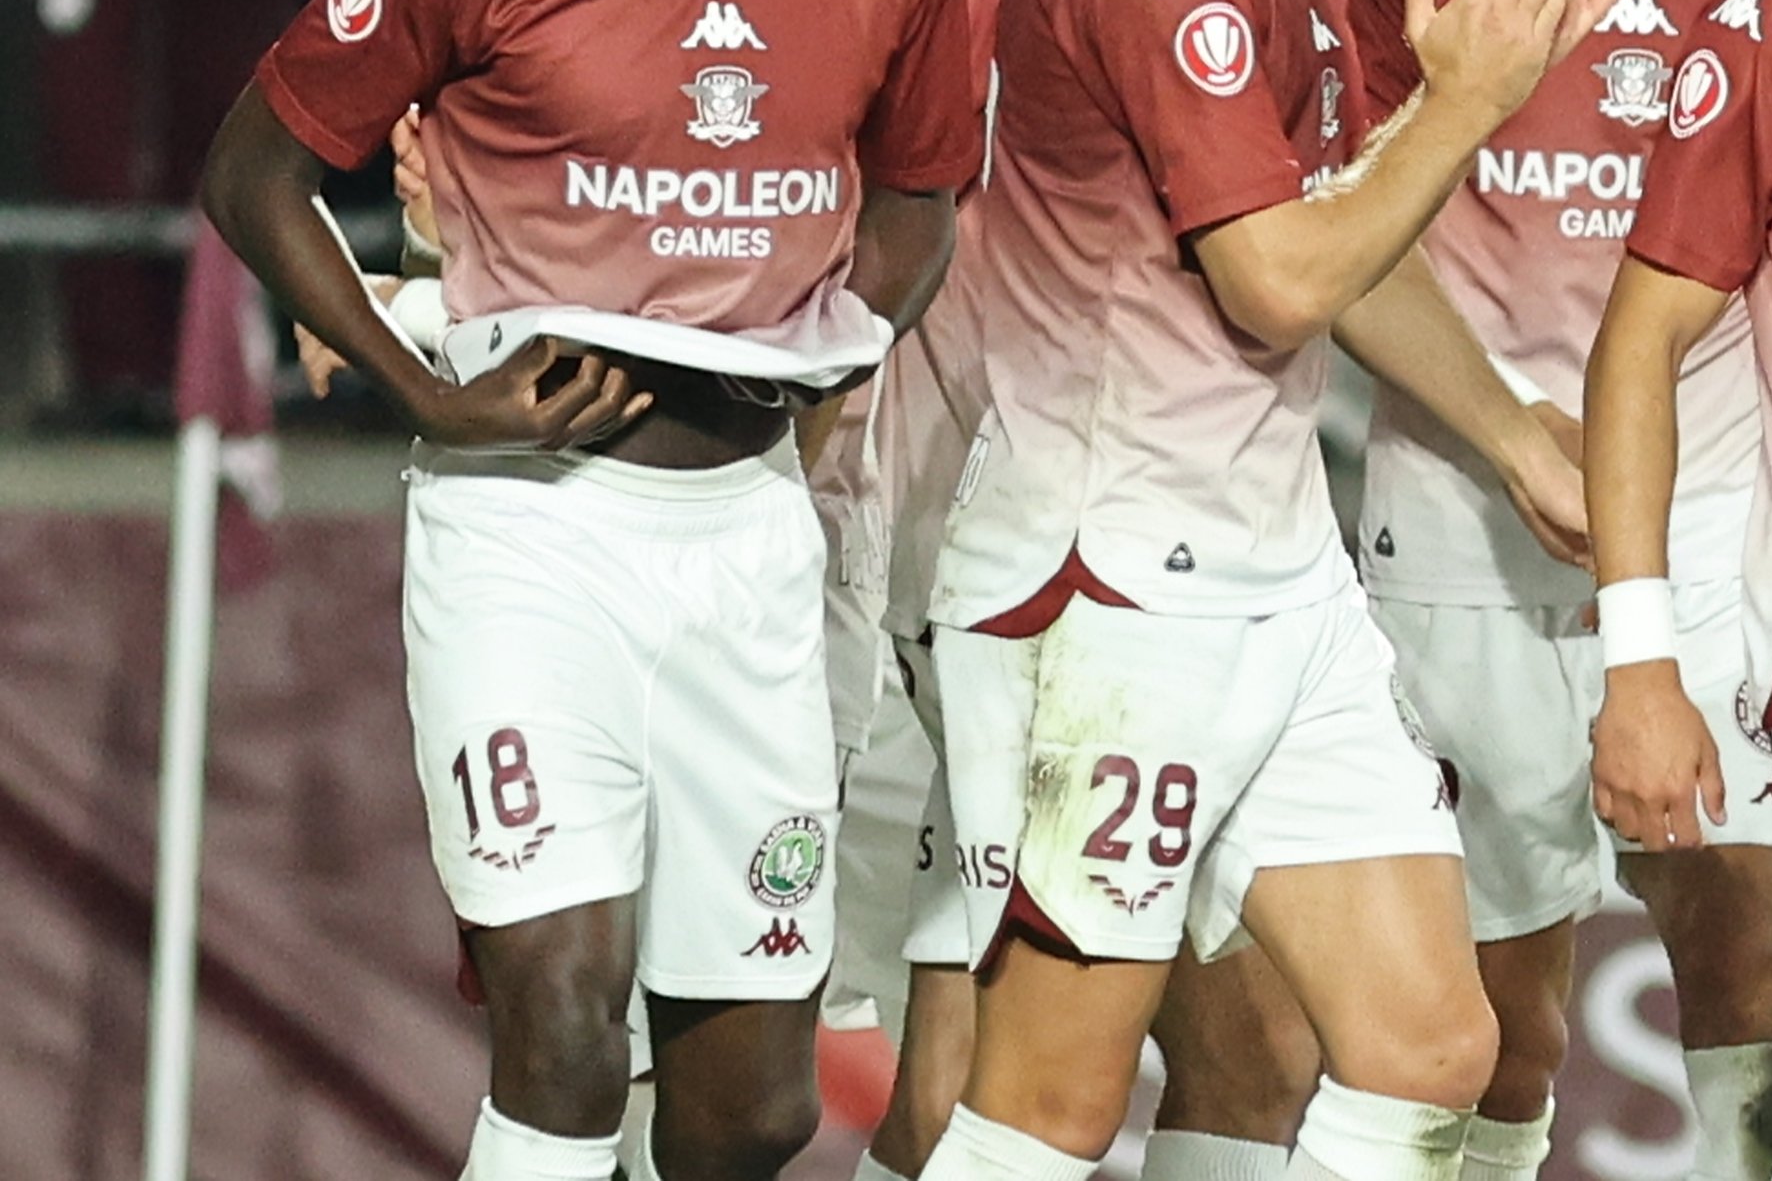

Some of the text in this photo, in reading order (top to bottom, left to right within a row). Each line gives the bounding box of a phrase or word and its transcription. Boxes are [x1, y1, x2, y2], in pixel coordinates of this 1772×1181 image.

[566, 160, 838, 217] NAPOLEON
[1478, 148, 1643, 200] NAPOL
[651, 226, 771, 258] GAMES
[1560, 207, 1635, 238] GAM
[452, 728, 540, 843] 18
[1082, 754, 1198, 867] 29
